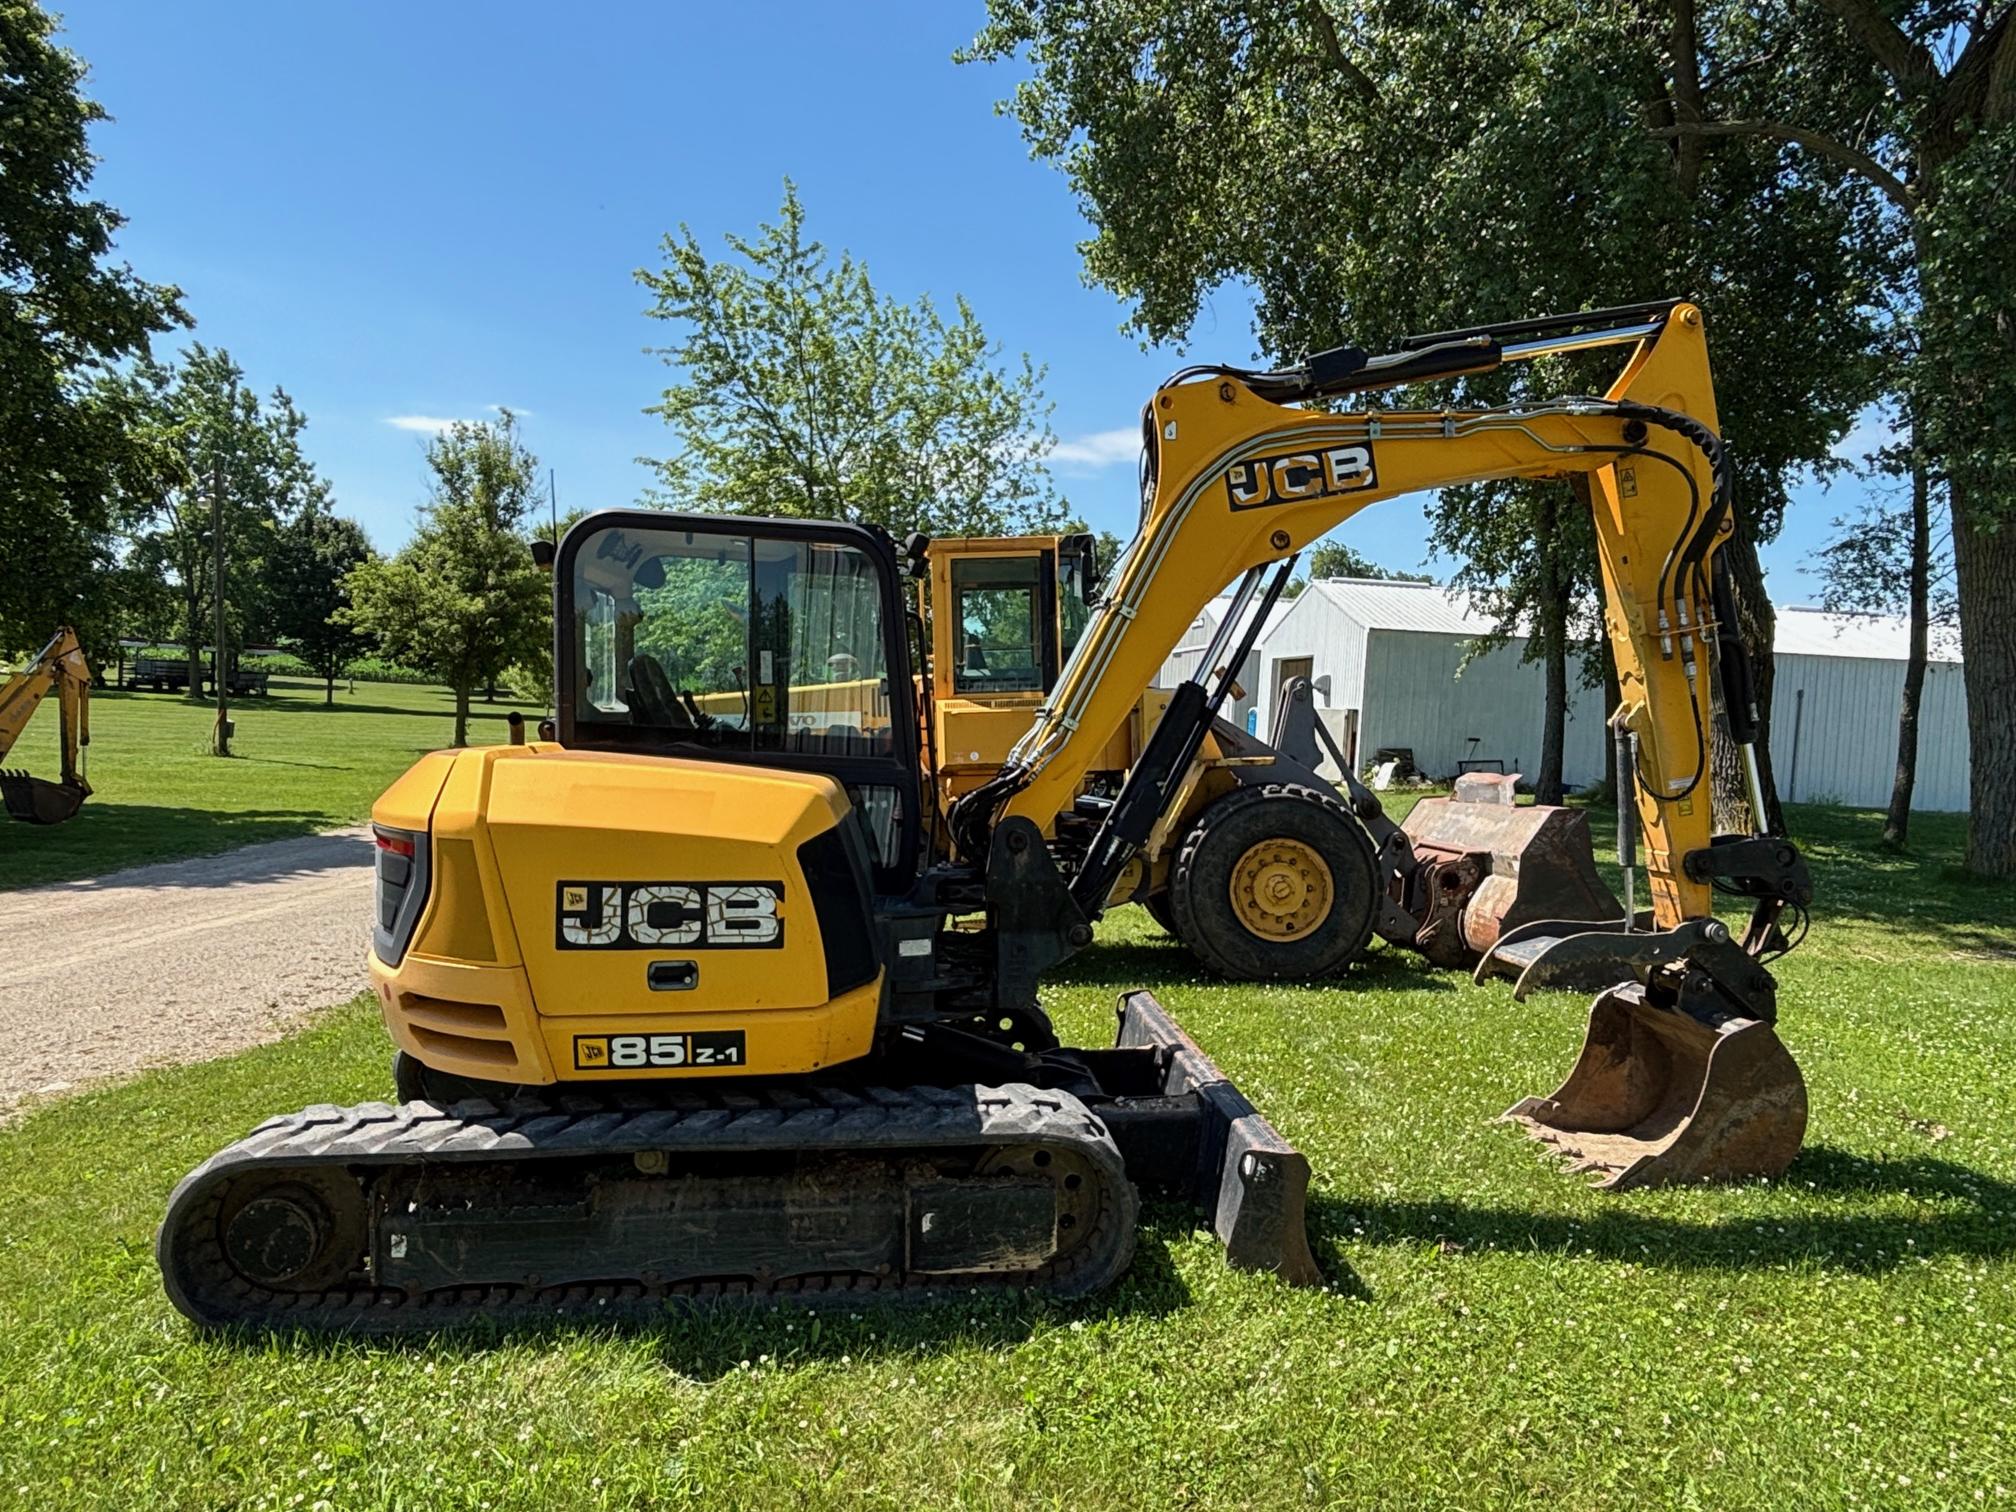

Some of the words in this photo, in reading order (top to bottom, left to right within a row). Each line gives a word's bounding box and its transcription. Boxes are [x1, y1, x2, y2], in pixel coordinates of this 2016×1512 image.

[1230, 446, 1374, 506] JCB
[563, 886, 780, 944] JCB
[611, 1036, 685, 1066] 85
[696, 1047, 738, 1063] Z-1
